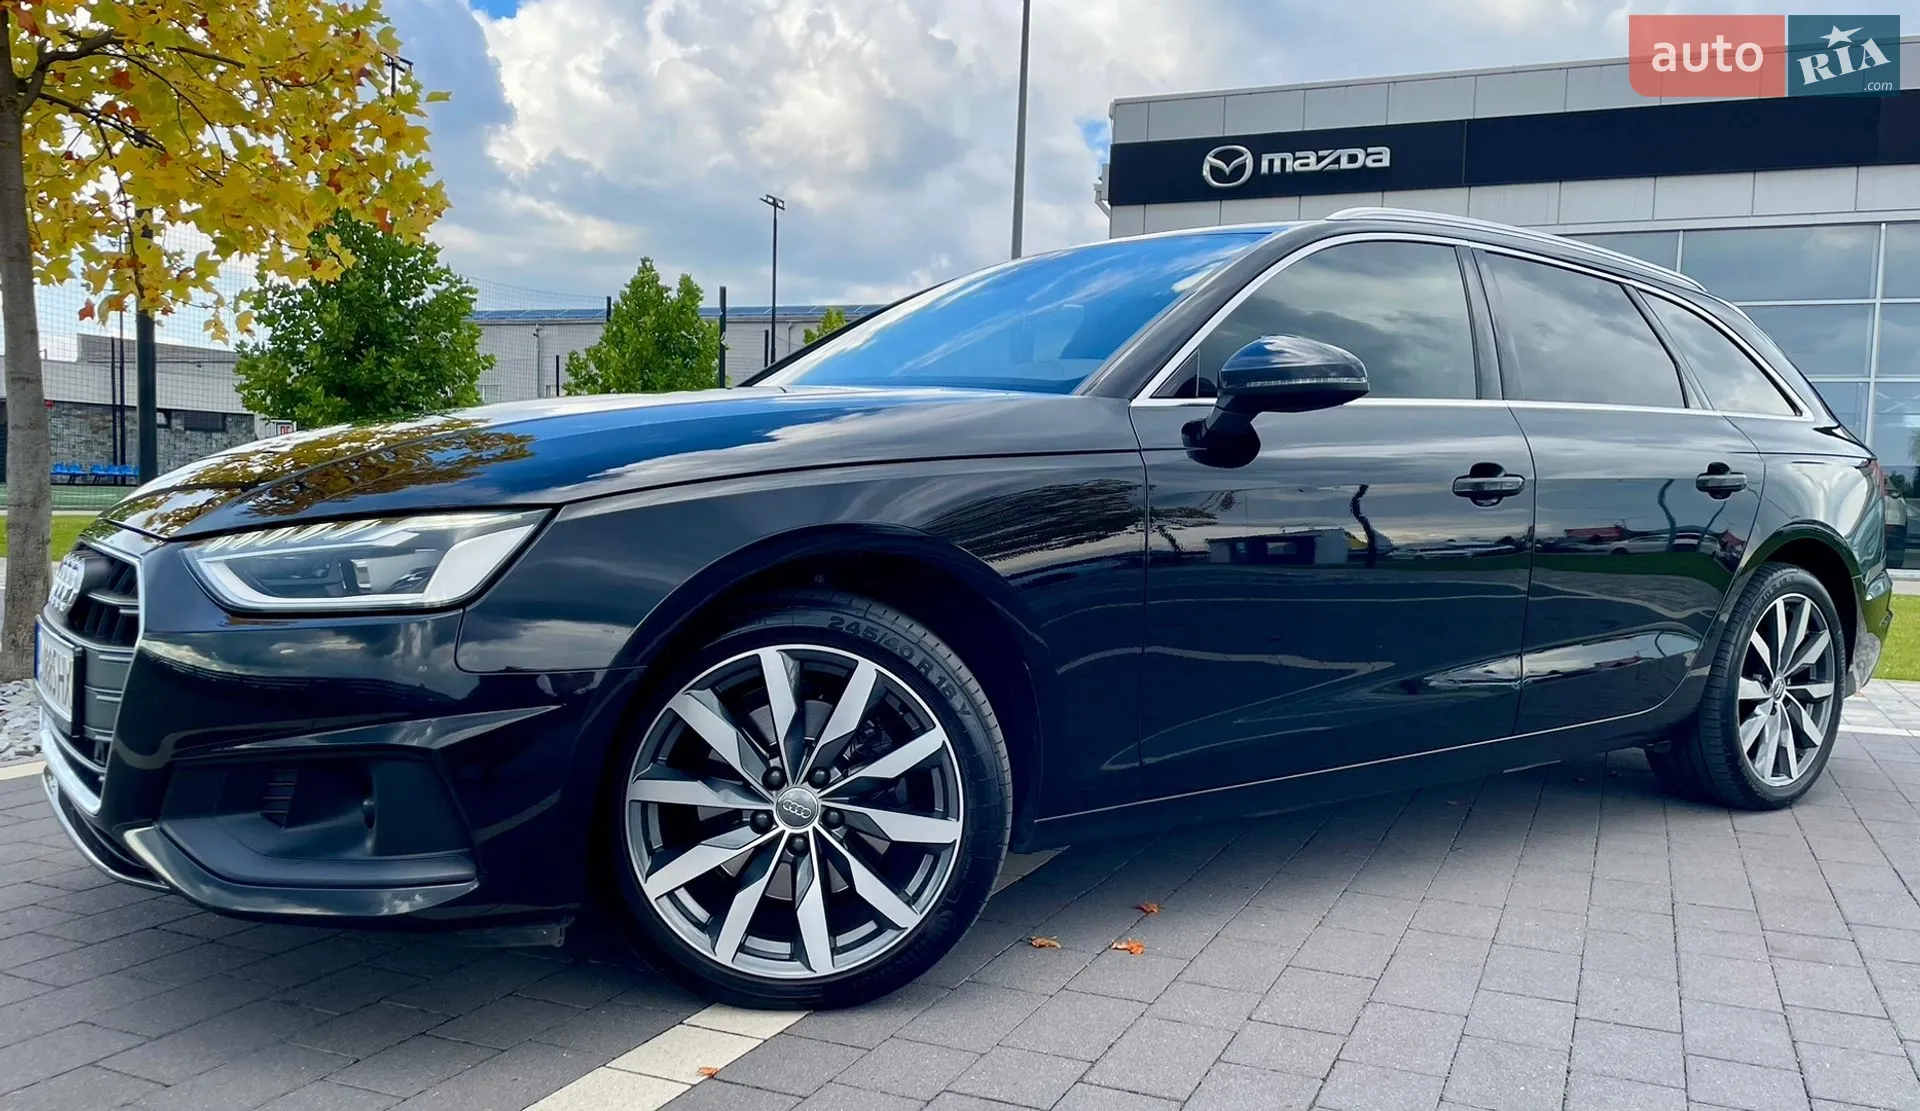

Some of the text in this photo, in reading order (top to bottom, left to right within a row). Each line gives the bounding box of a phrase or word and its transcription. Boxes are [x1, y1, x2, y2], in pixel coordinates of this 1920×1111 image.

[827, 615, 915, 660] 245/40
[915, 658, 936, 678] R
[936, 676, 958, 698] 18
